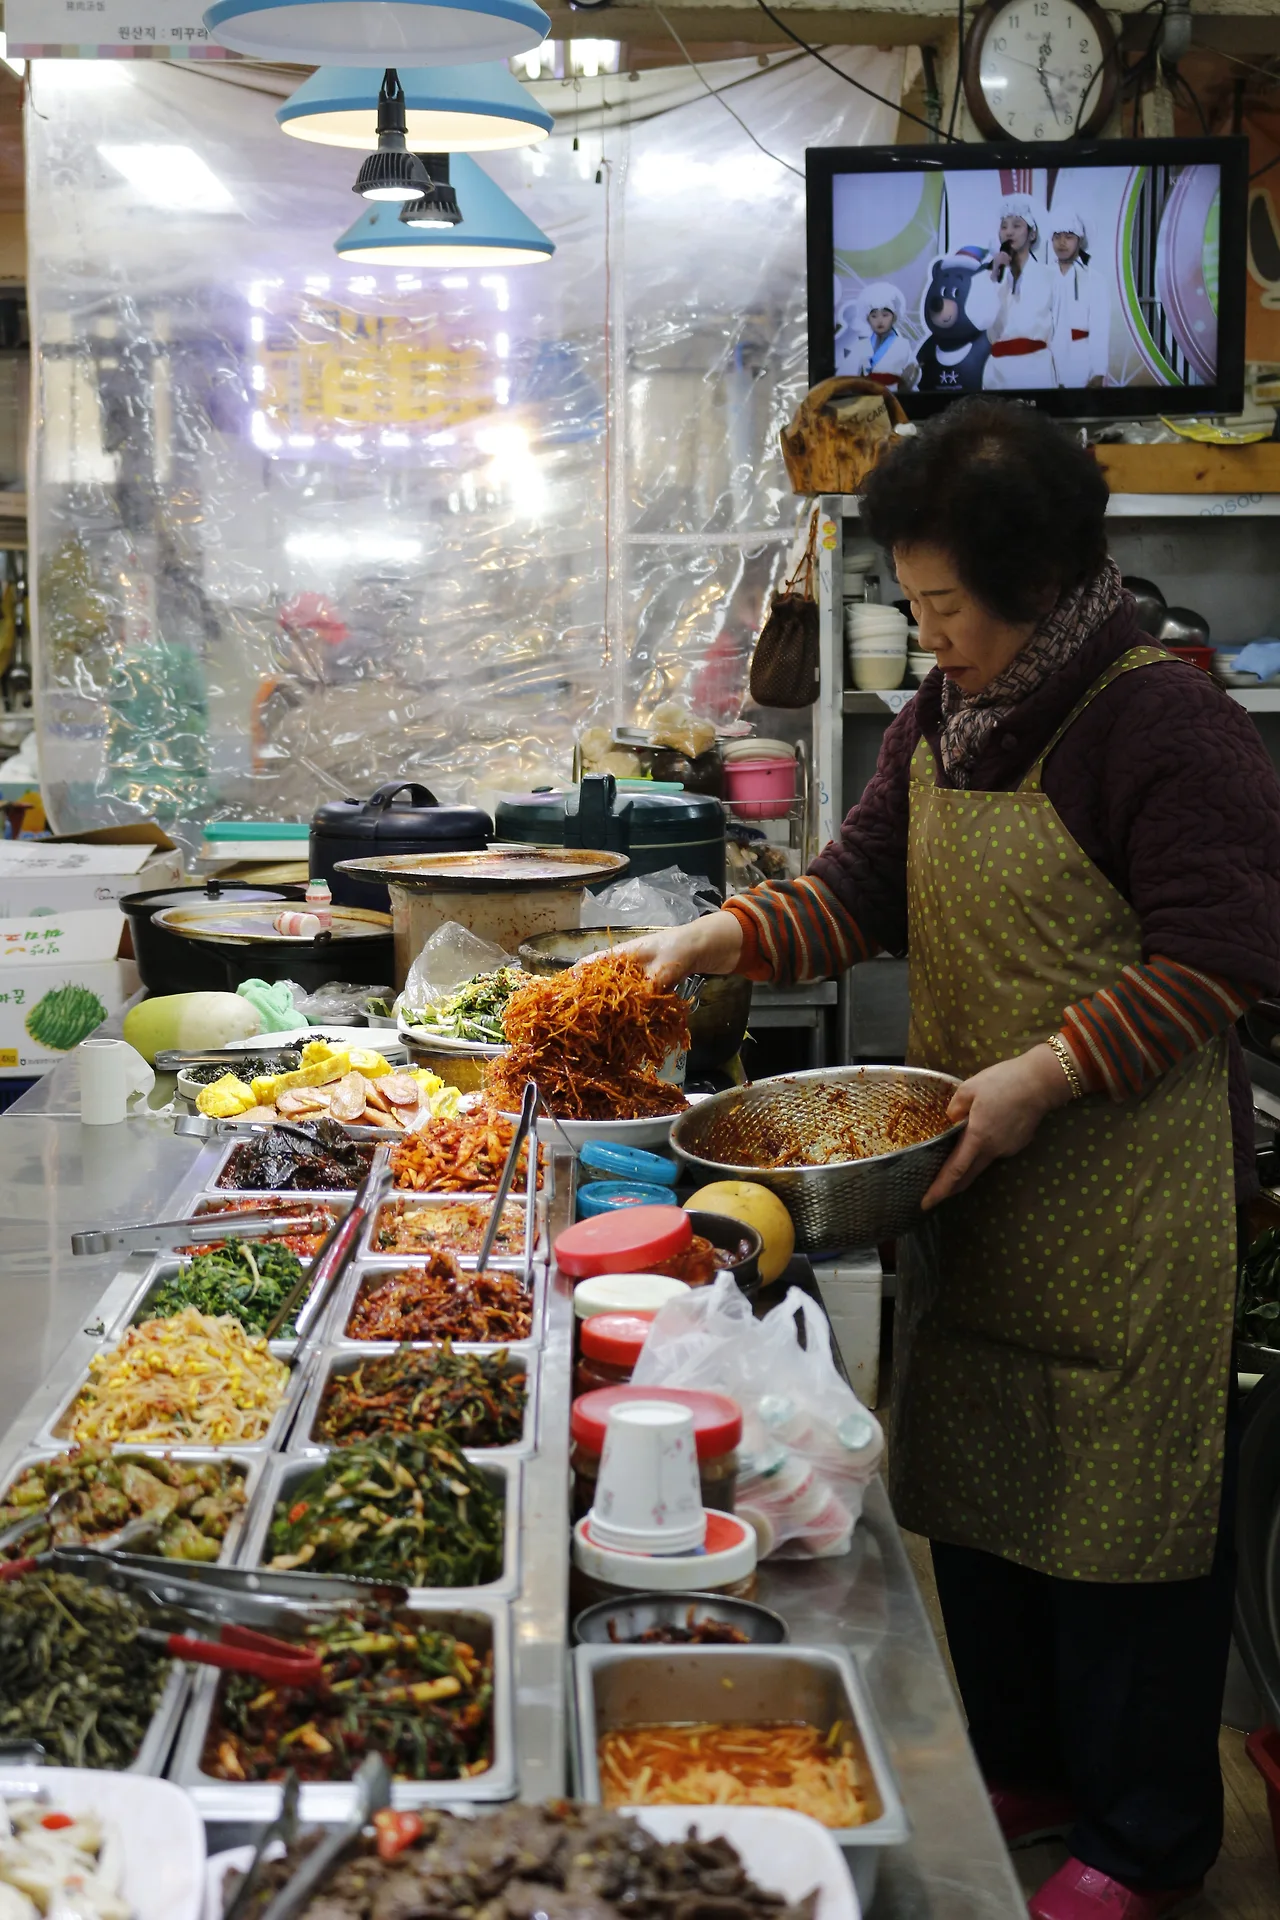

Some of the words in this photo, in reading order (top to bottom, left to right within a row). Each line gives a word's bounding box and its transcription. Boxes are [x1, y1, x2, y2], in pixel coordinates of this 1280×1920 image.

[1033, 2, 1049, 17] 12
[1008, 16, 1020, 29] 11
[1066, 16, 1073, 29] 1
[117, 26, 156, 41] 원산지
[993, 37, 1007, 52] 10
[1079, 39, 1088, 53] 2
[1083, 64, 1093, 79] 3
[992, 91, 1003, 106] 8
[1007, 112, 1017, 127] 7
[1064, 107, 1073, 126] 5
[1034, 123, 1044, 138] 6
